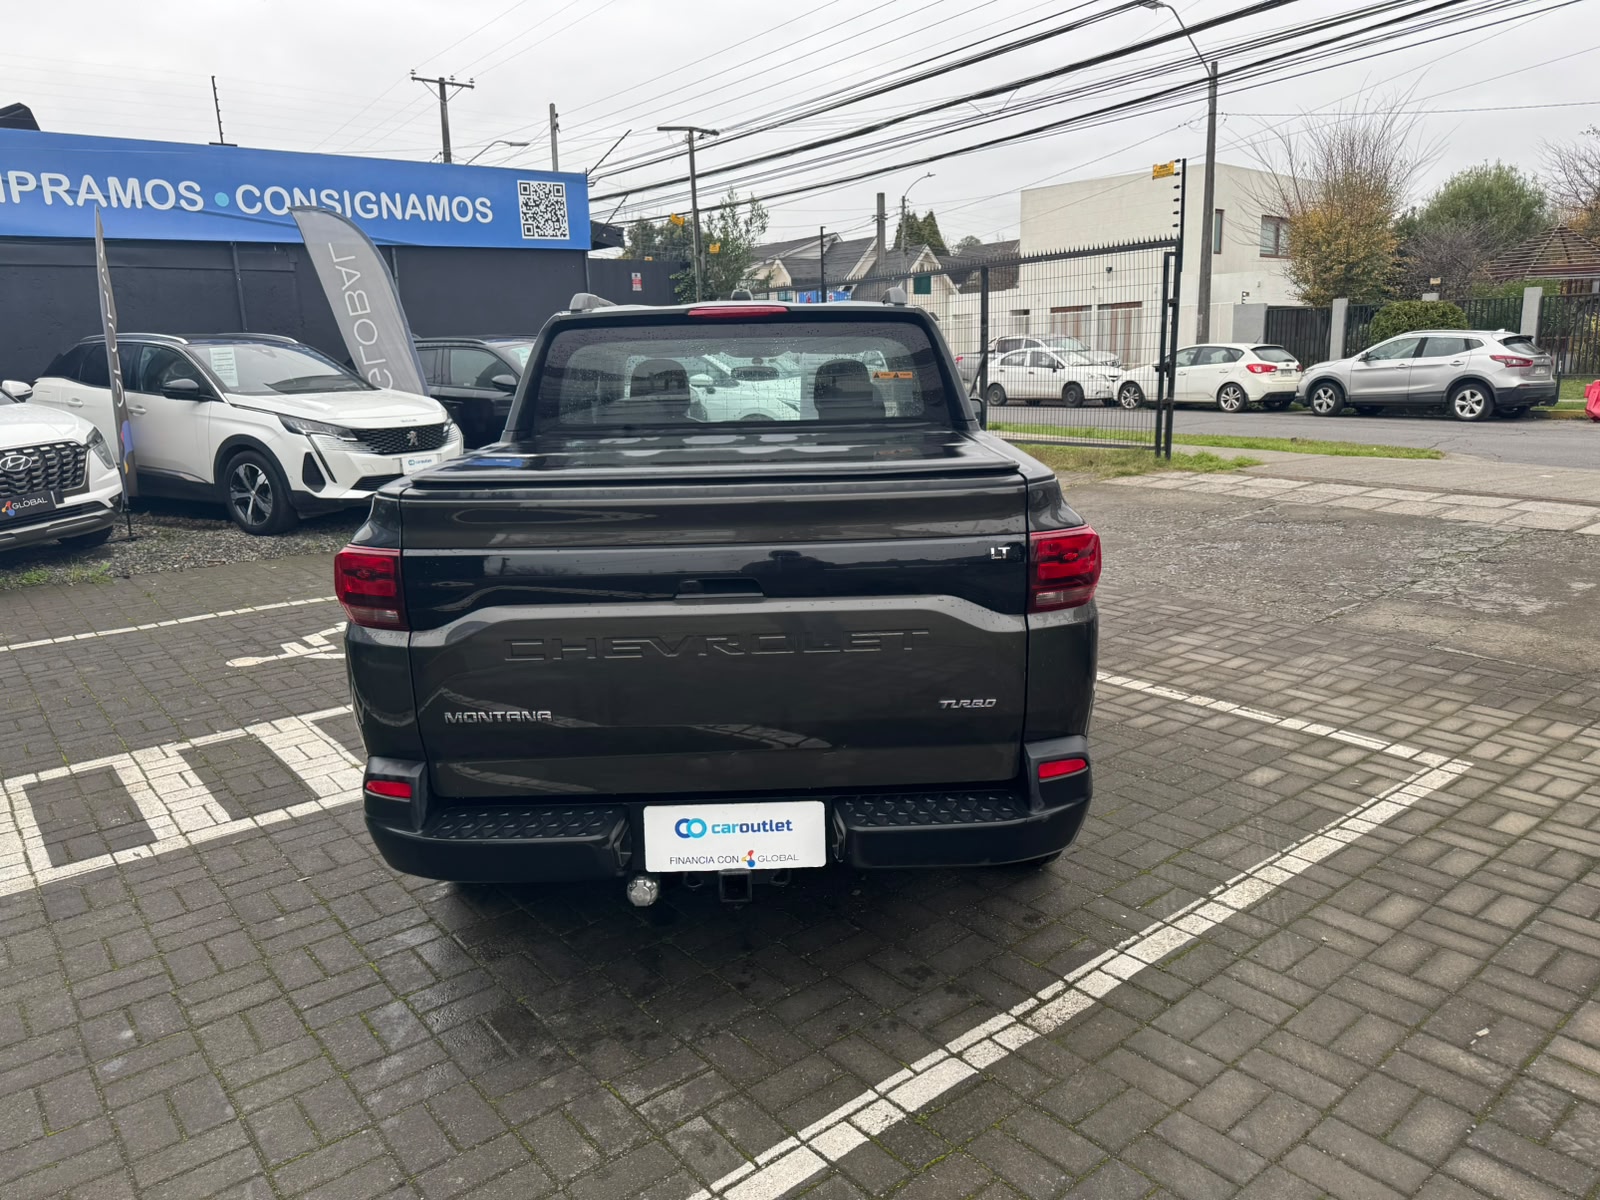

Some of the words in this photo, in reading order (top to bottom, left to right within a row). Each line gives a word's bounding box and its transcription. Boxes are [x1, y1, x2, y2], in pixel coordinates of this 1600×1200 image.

[0, 170, 204, 212] PRAMOS
[235, 184, 493, 224] CONSIGNAMOS
[12, 497, 48, 510] GLOBAL
[990, 546, 1011, 560] LT
[503, 628, 930, 662] CHEVROLET
[939, 698, 997, 709] TURBO
[444, 710, 552, 724] MONTANA
[711, 819, 793, 834] caroutlet
[669, 856, 715, 865] FINANCIA
[717, 855, 739, 864] CON
[757, 854, 800, 863] GLOBAL
